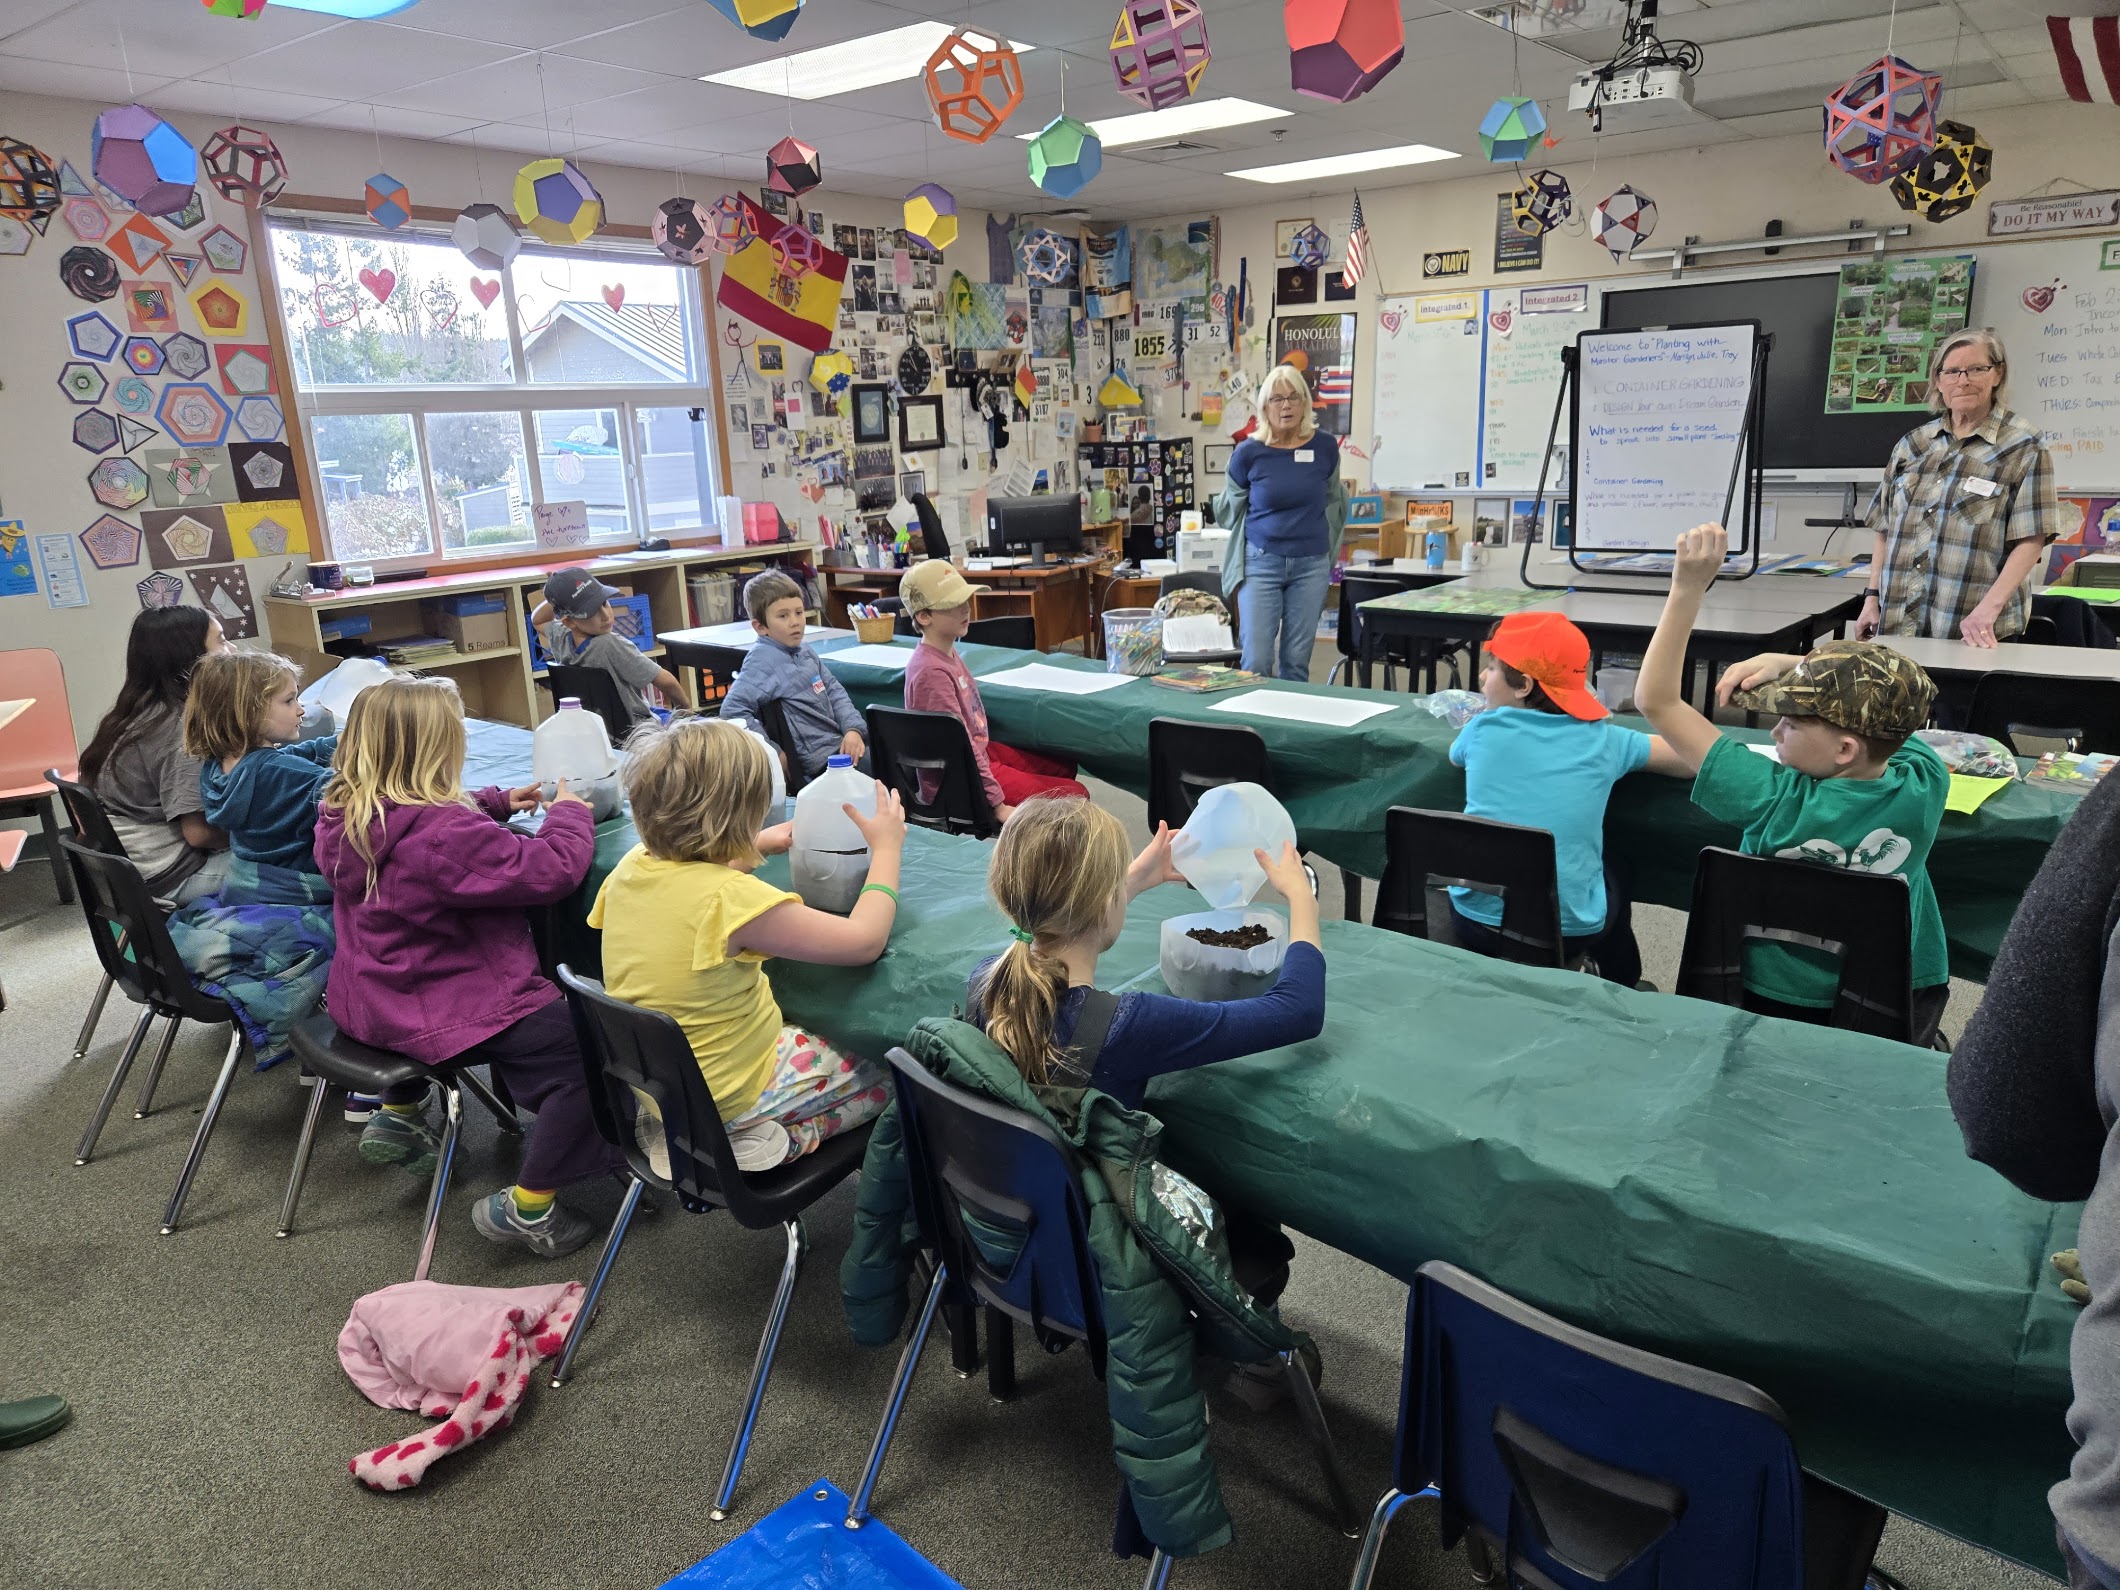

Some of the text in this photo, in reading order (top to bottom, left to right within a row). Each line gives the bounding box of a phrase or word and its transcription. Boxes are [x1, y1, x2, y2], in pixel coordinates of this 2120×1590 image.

[2034, 200, 2082, 211] Reasonable!
[2004, 206, 2105, 227] DO IT MY WAY
[1442, 253, 1468, 272] NAVY
[2075, 292, 2096, 308] Feb
[1114, 329, 1130, 342] 880
[1188, 327, 1198, 340] 31
[1210, 326, 1220, 337] 52
[1285, 327, 1341, 341] HONOLUL
[2075, 323, 2104, 337] Intro
[1134, 336, 1165, 357] 1855
[1285, 341, 1341, 351] MARATHO
[1588, 341, 1631, 353] Welcome
[1639, 339, 1649, 350] to
[1697, 337, 1726, 348] with
[1591, 356, 1617, 365] Master
[1229, 377, 1242, 394] 140
[1603, 380, 1676, 394] CONTAINER
[1679, 376, 1744, 390] GARDENING
[1086, 385, 1092, 404] 3
[1603, 402, 1634, 412] DESIGN
[1589, 425, 1616, 437] What
[1619, 425, 1629, 434] is
[1632, 425, 1664, 433] needed
[1694, 424, 1718, 432] seed
[1594, 477, 1664, 486] Container Gardening
[468, 640, 506, 651] 5 Reams
